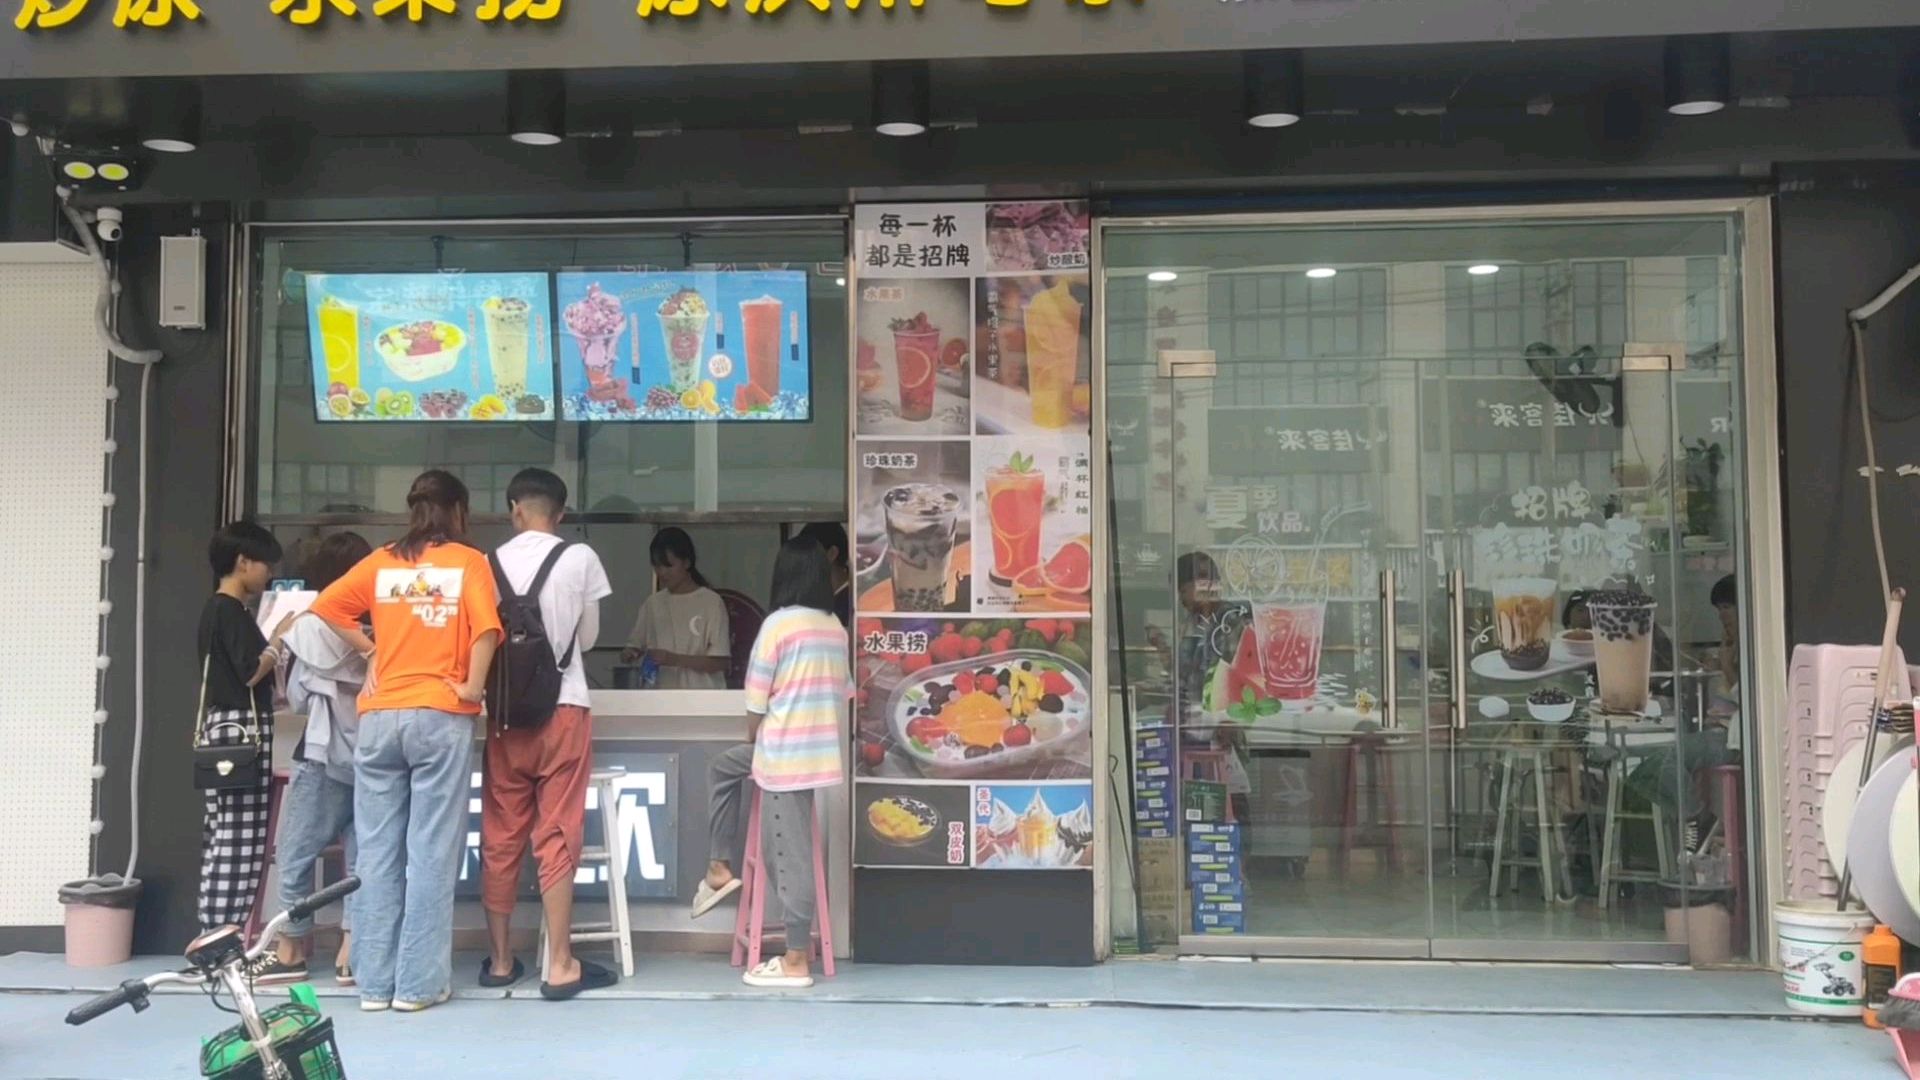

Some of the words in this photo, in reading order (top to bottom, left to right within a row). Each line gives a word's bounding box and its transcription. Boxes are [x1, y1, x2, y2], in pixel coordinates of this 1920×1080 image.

[878, 213, 958, 238] 每一杯
[865, 243, 970, 268] 都是招牌
[1049, 253, 1087, 268] 炒酸奶
[864, 454, 918, 468] 珍珠奶茶
[1511, 480, 1592, 521] 招牌
[865, 632, 927, 652] 水果捞
[977, 788, 991, 816] 圣代
[949, 823, 964, 864] 双皮奶
